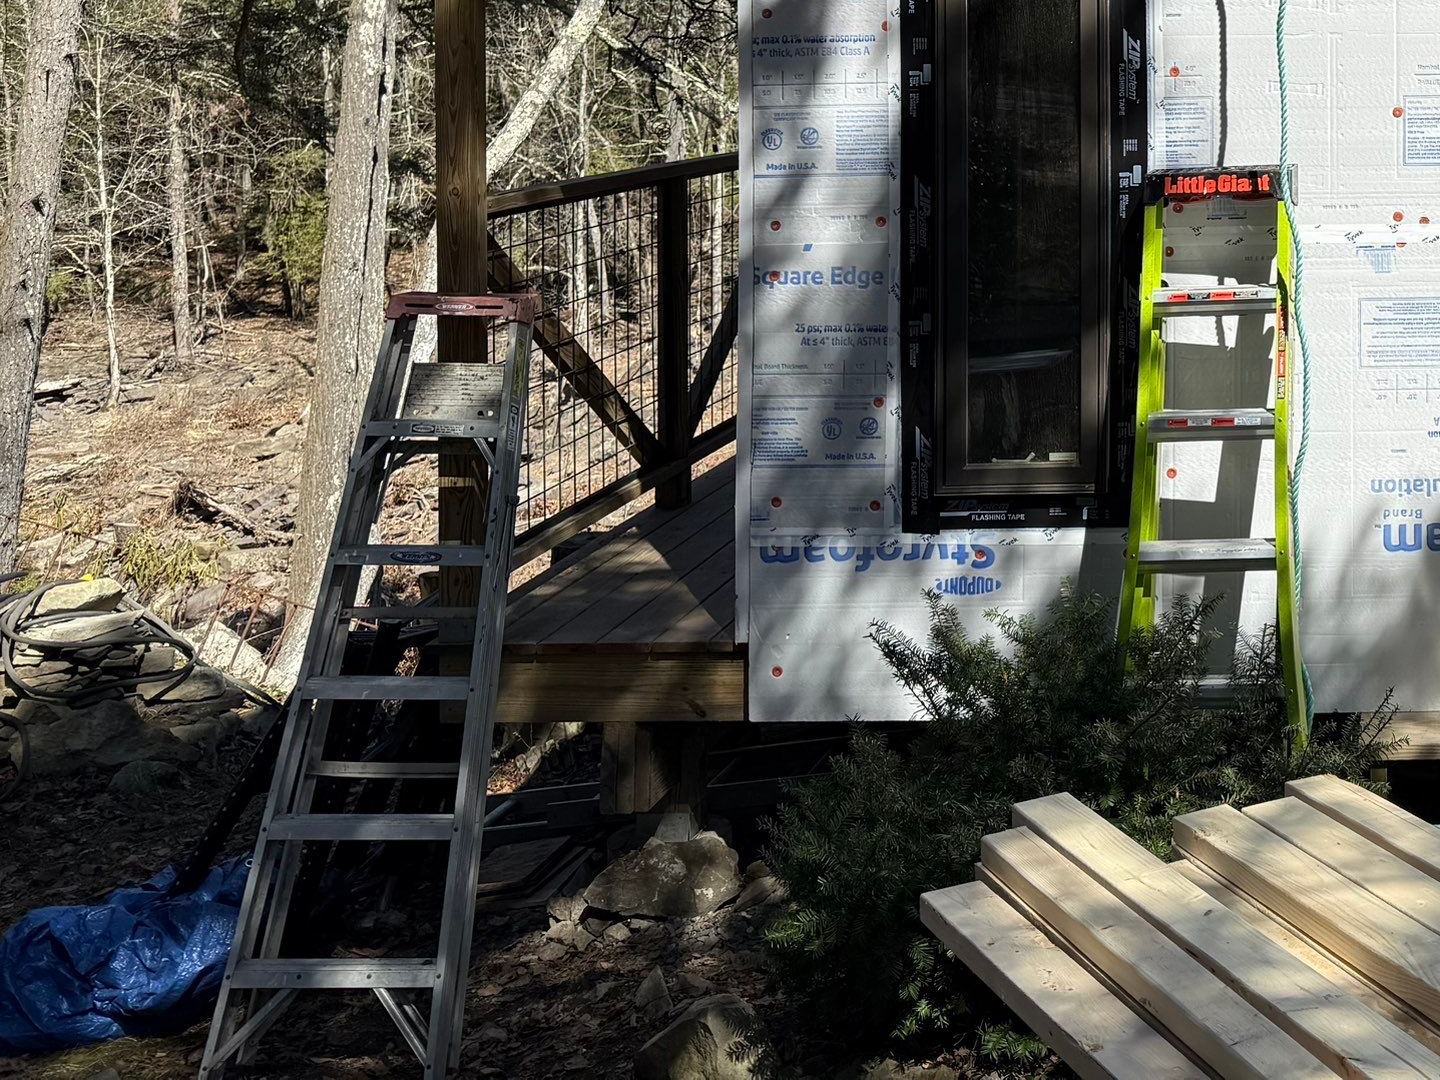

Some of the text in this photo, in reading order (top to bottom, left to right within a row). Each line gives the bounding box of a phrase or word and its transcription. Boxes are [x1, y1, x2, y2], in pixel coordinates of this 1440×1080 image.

[761, 33, 875, 44] max 0.1% water absorption
[769, 47, 793, 58] thick,
[794, 47, 819, 57] ASTM
[821, 47, 838, 57] E84
[840, 46, 861, 57] Class
[862, 46, 870, 56] A
[1128, 39, 1141, 69] ZIP
[766, 163, 784, 171] Made
[1164, 174, 1216, 194] Little
[830, 266, 883, 289] Edge
[795, 323, 805, 332] 25
[824, 324, 843, 332] max
[844, 322, 864, 332] 0.1%
[866, 323, 888, 332] wate
[801, 337, 811, 346] At
[831, 336, 854, 348] thick,
[857, 337, 881, 346] ASTM
[1434, 416, 1440, 425] A
[920, 433, 933, 467] ZIP
[971, 513, 1026, 521] FLASHING TAPE
[1383, 509, 1422, 518] Brand
[941, 576, 996, 596] DUPONT
